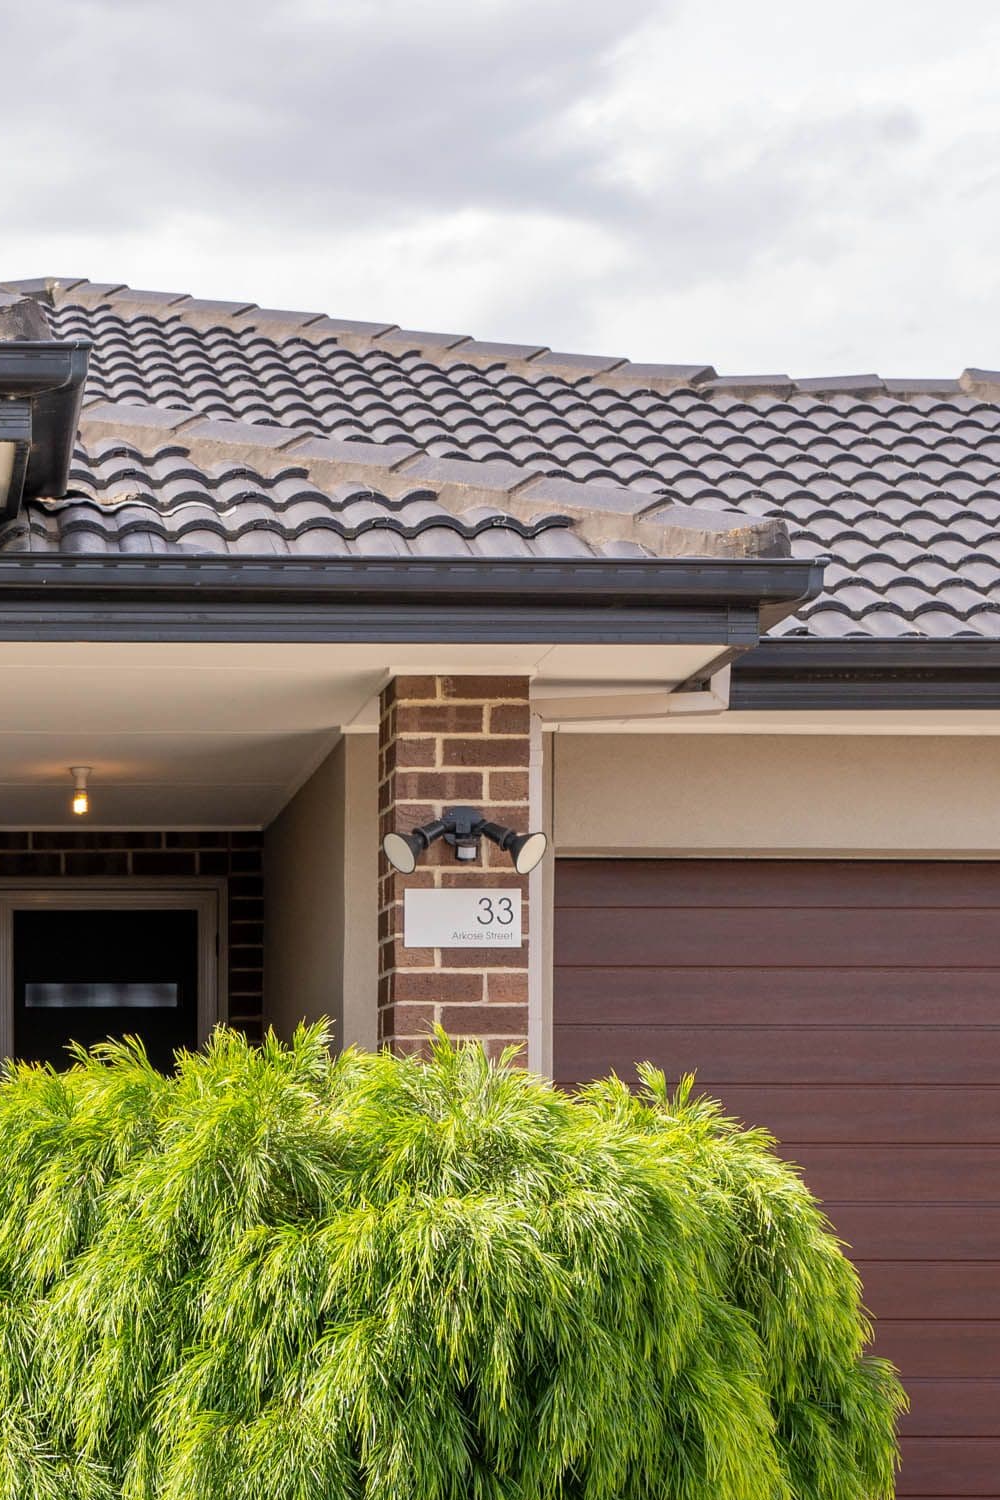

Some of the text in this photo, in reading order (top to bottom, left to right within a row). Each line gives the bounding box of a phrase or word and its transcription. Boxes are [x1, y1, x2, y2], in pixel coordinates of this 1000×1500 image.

[477, 897, 514, 925] 33
[452, 931, 513, 941] Arkose Street
